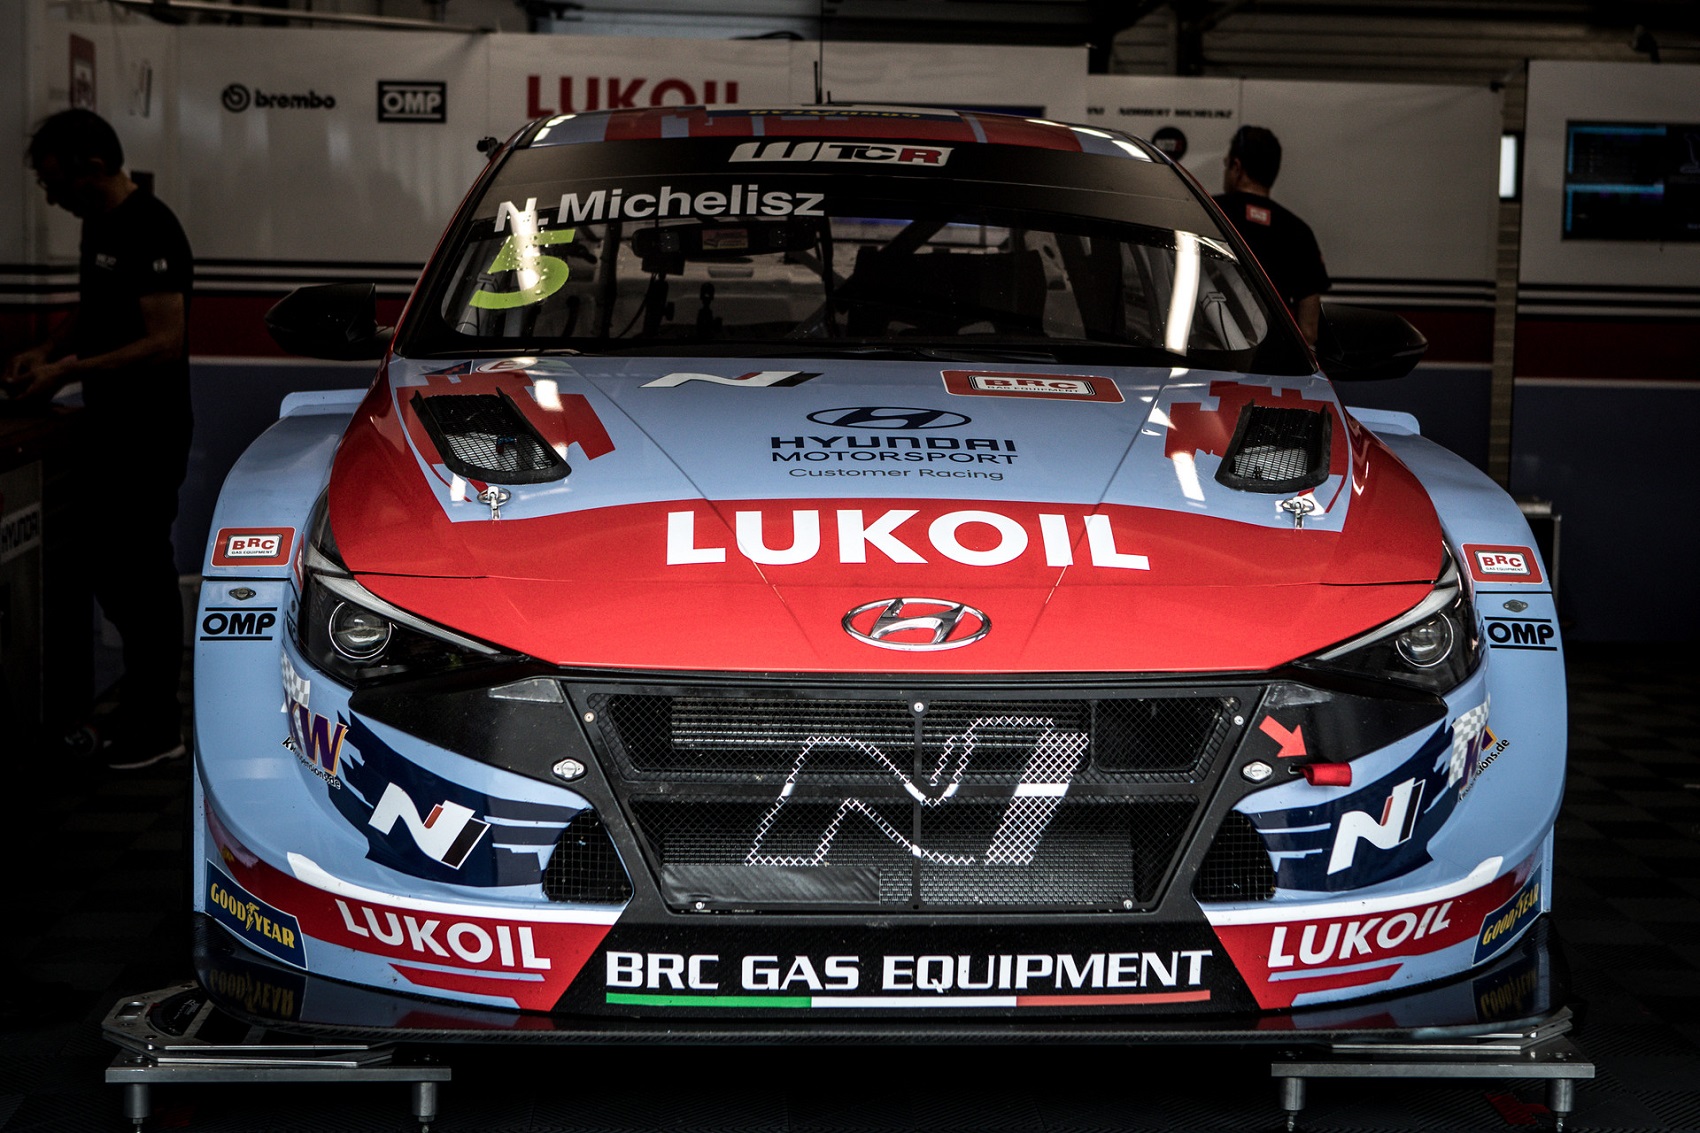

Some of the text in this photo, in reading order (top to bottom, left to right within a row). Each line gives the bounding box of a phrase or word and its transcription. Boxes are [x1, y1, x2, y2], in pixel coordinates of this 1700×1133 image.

[255, 90, 335, 108] brembo
[381, 91, 441, 114] OMP
[469, 228, 576, 310] 5
[983, 379, 1079, 389] BRC
[771, 435, 1017, 452] HYUNDAI
[772, 451, 1018, 464] MOTORSPORT
[789, 468, 1004, 481] Customer Racing
[232, 538, 275, 550] BRC
[666, 509, 1150, 571] LUKOIL
[1482, 555, 1522, 568] BRC
[202, 612, 276, 635] OMP
[1487, 622, 1555, 645] OMP
[210, 882, 295, 949] GOODYEAR
[1482, 882, 1539, 946] GOODYEAR
[335, 898, 551, 970] LUKOIL
[1267, 901, 1454, 968] LUKOIL
[606, 949, 1213, 994] BRC GAS EQUIPMENT
